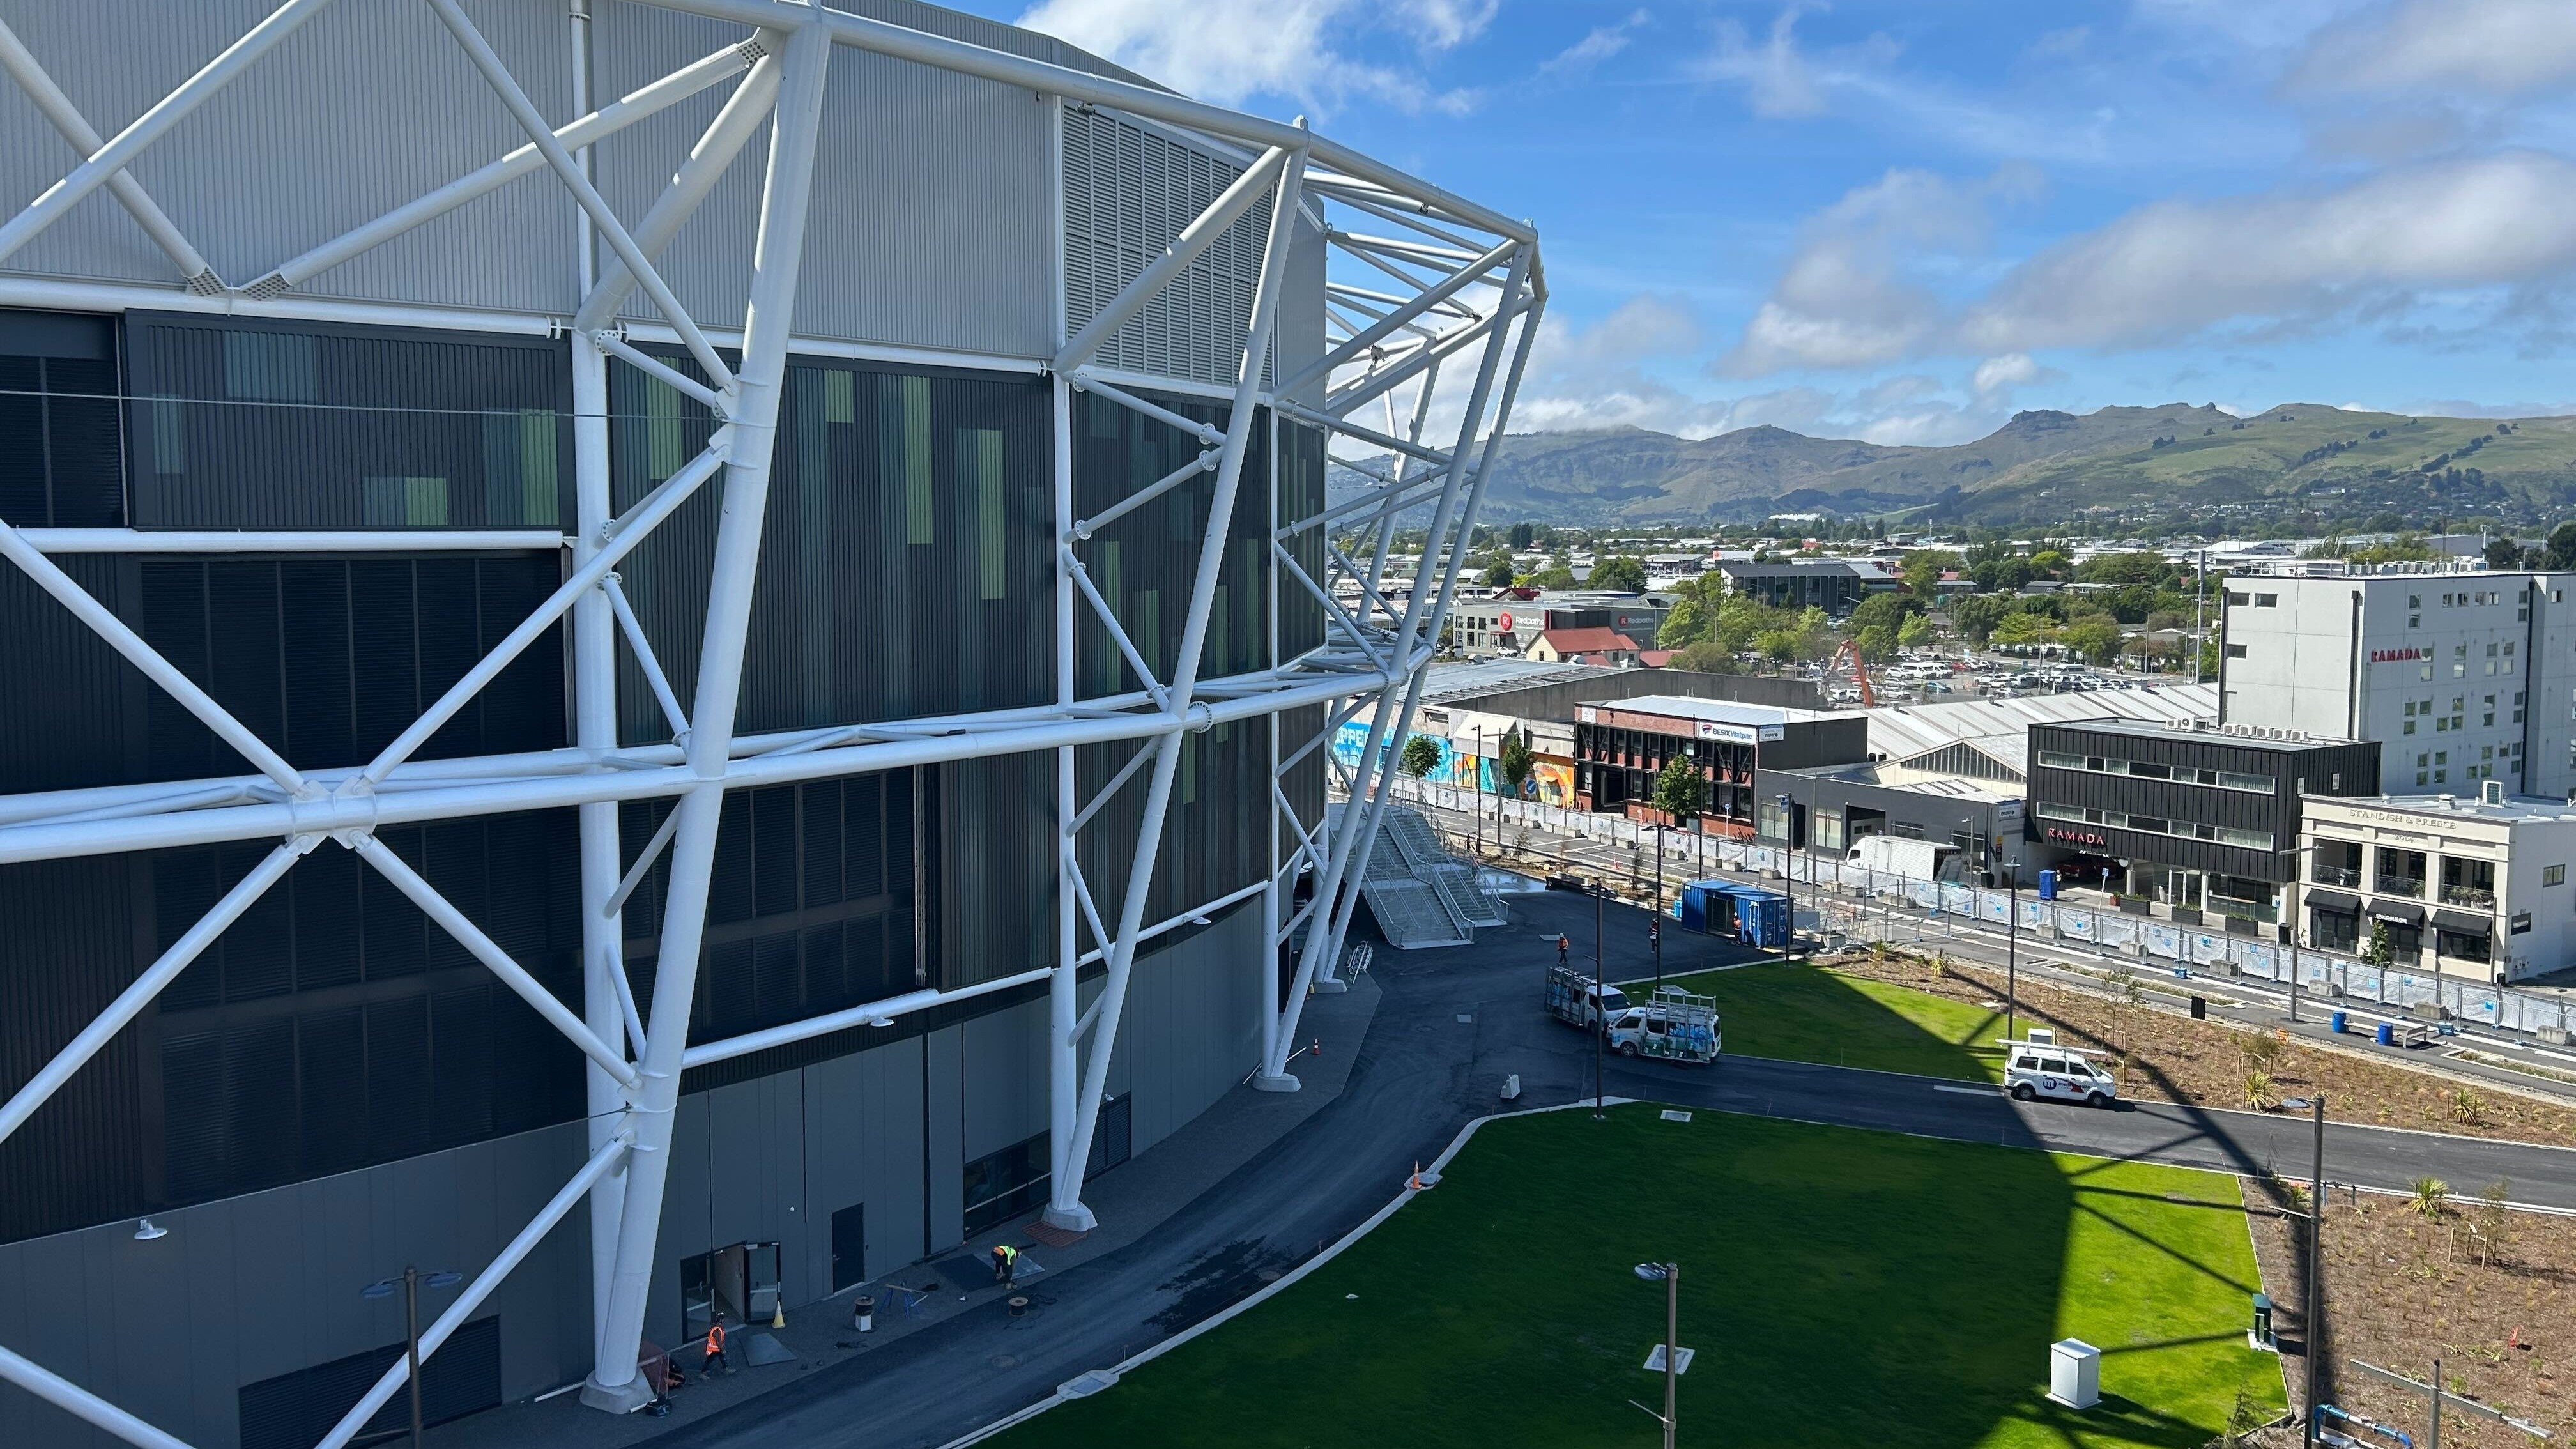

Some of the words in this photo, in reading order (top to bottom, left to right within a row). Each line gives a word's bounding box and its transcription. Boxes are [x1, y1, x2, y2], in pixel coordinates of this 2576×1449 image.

[1515, 616, 1544, 625] Redpaths
[2371, 648, 2421, 662] RAMADA
[1713, 728, 1731, 737] BESIX
[1731, 730, 1753, 740] Watpac
[2350, 809, 2403, 823] STANDISH
[2416, 817, 2457, 829] PREECE
[2048, 827, 2104, 845] RAMADA
